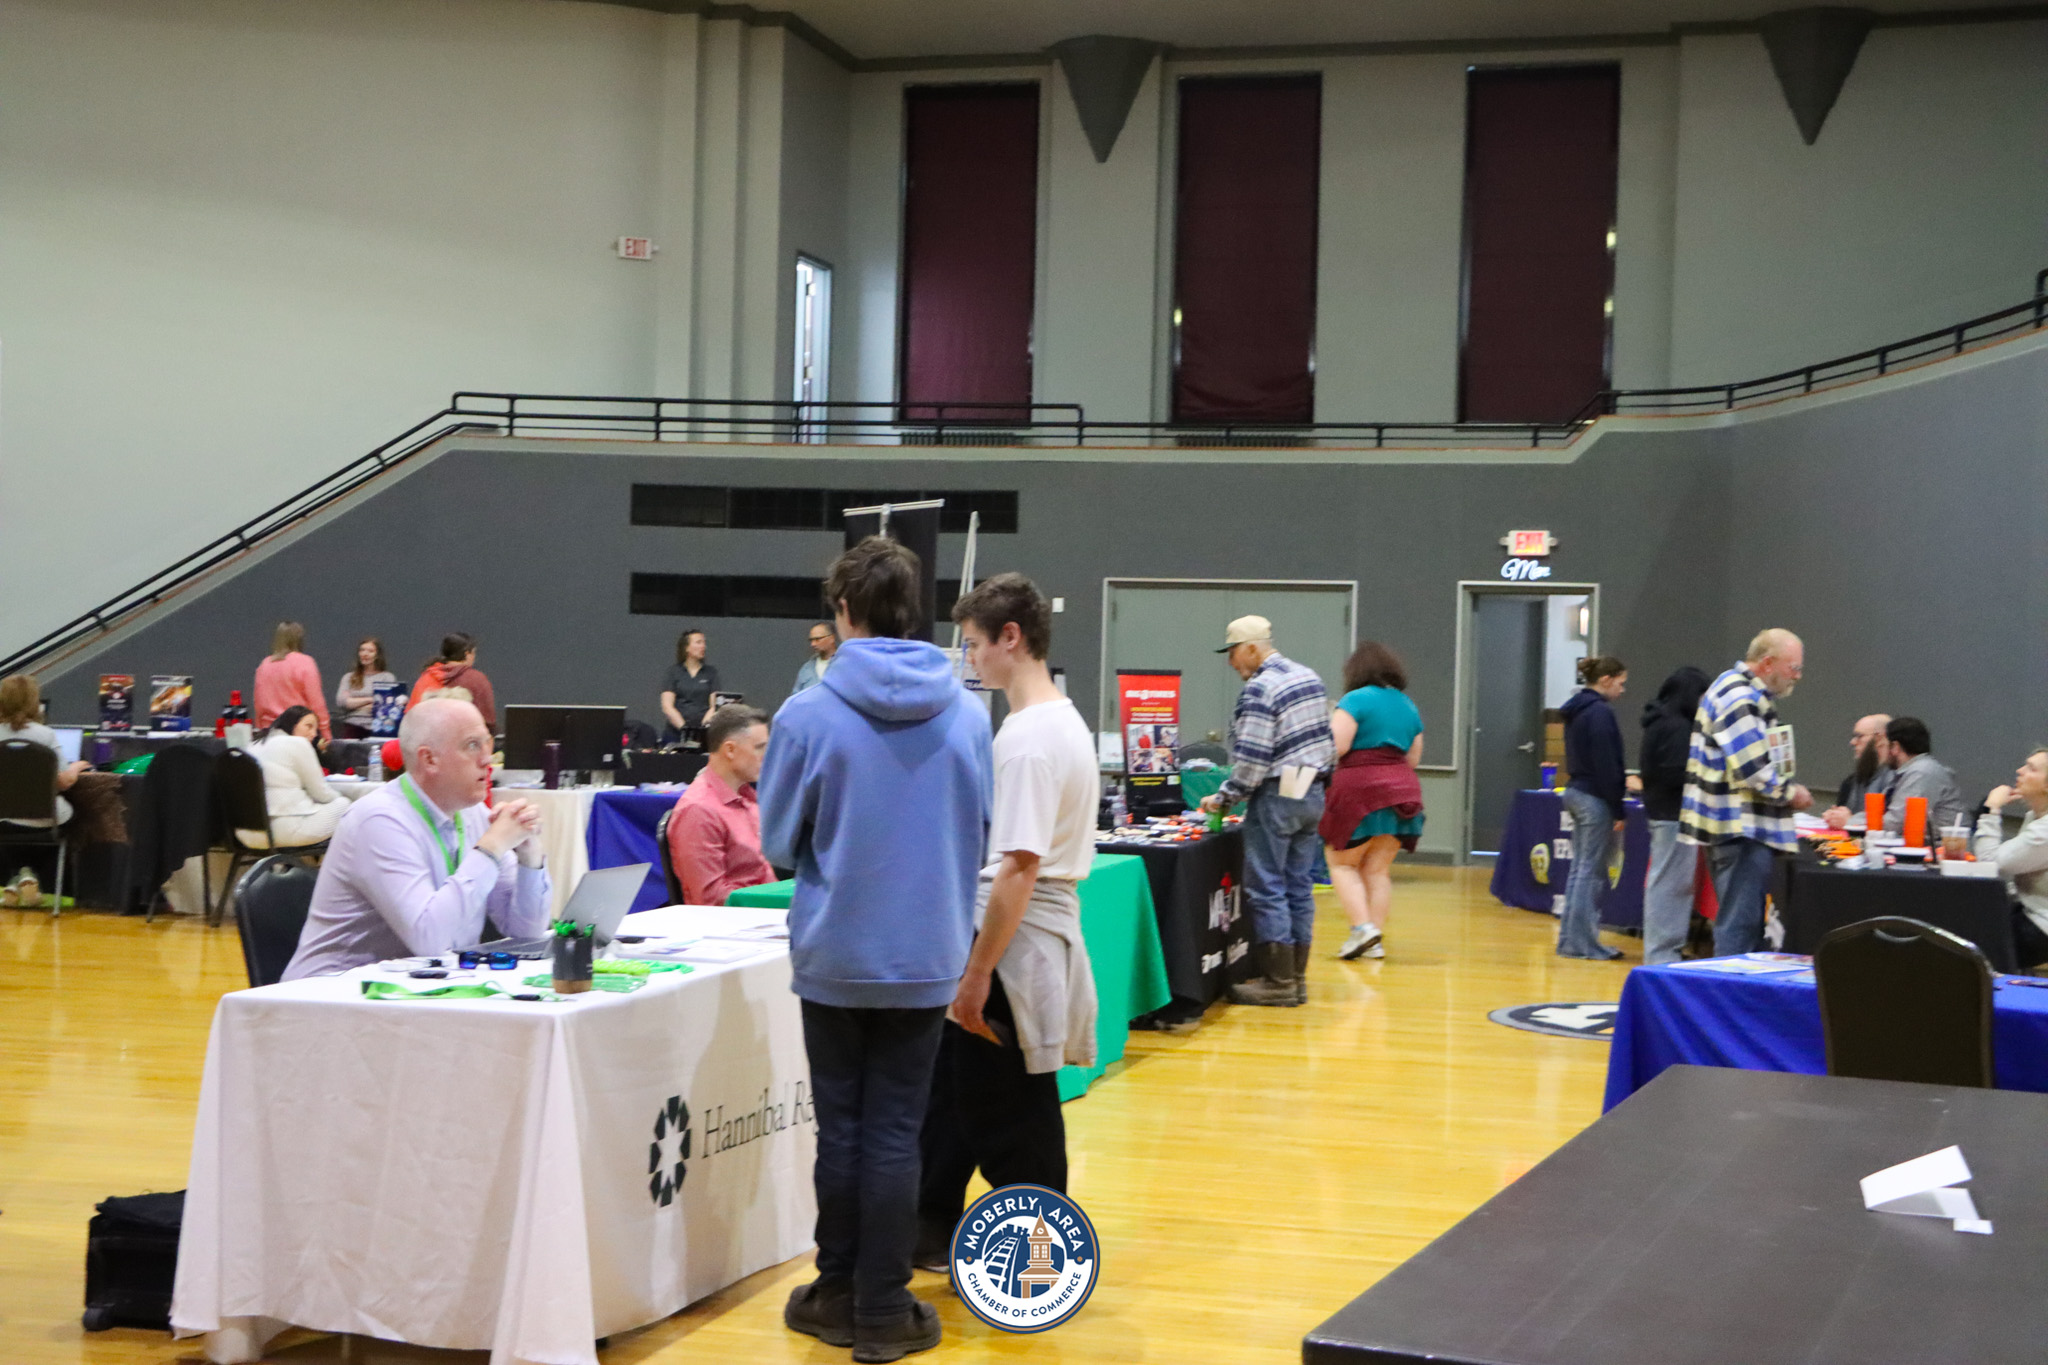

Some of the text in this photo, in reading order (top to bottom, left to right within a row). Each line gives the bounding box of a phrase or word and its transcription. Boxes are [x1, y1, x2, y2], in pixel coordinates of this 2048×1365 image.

[625, 238, 648, 256] EXIT
[1515, 532, 1544, 553] EXIT
[701, 1082, 790, 1158] Hannibal
